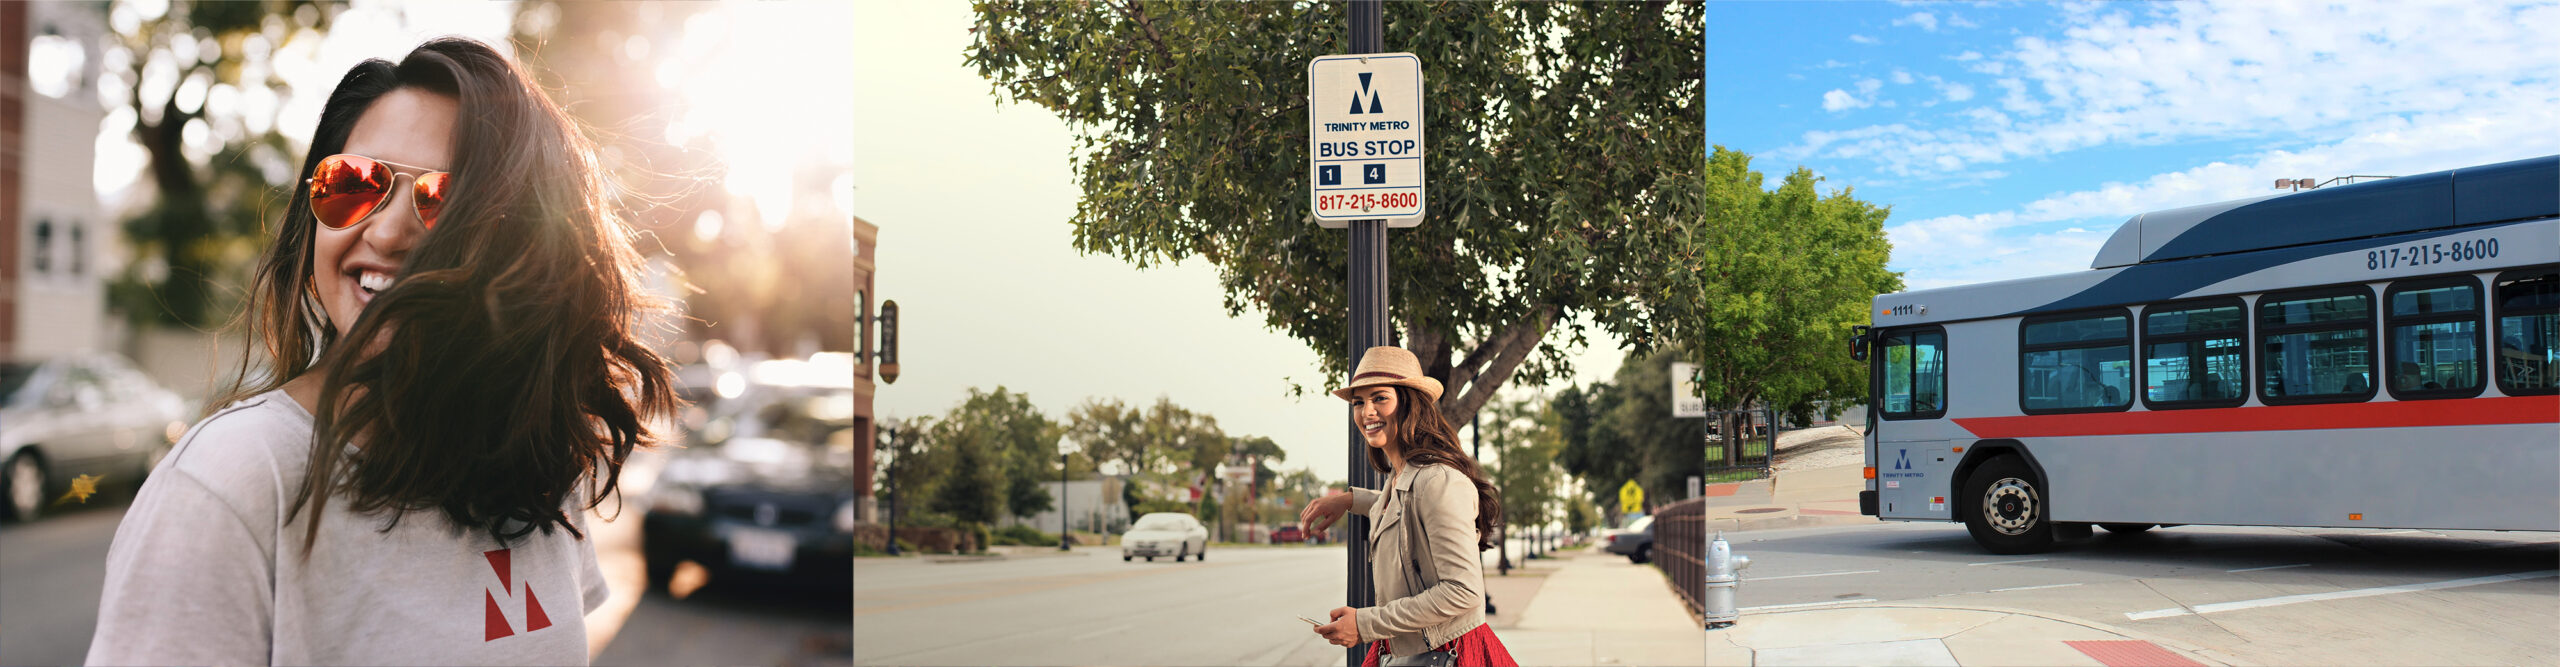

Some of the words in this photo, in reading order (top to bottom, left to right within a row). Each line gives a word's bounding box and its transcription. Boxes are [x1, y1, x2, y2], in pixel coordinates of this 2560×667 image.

[1324, 122, 1367, 132] TRINITY
[1369, 120, 1410, 131] METRO
[1320, 141, 1359, 157] BUS
[1364, 139, 1415, 156] STOP
[1369, 167, 1379, 180] 4
[1319, 192, 1418, 211] 817-215-8600
[2367, 237, 2499, 271] 817-215-8600
[1892, 304, 1913, 316] 1111
